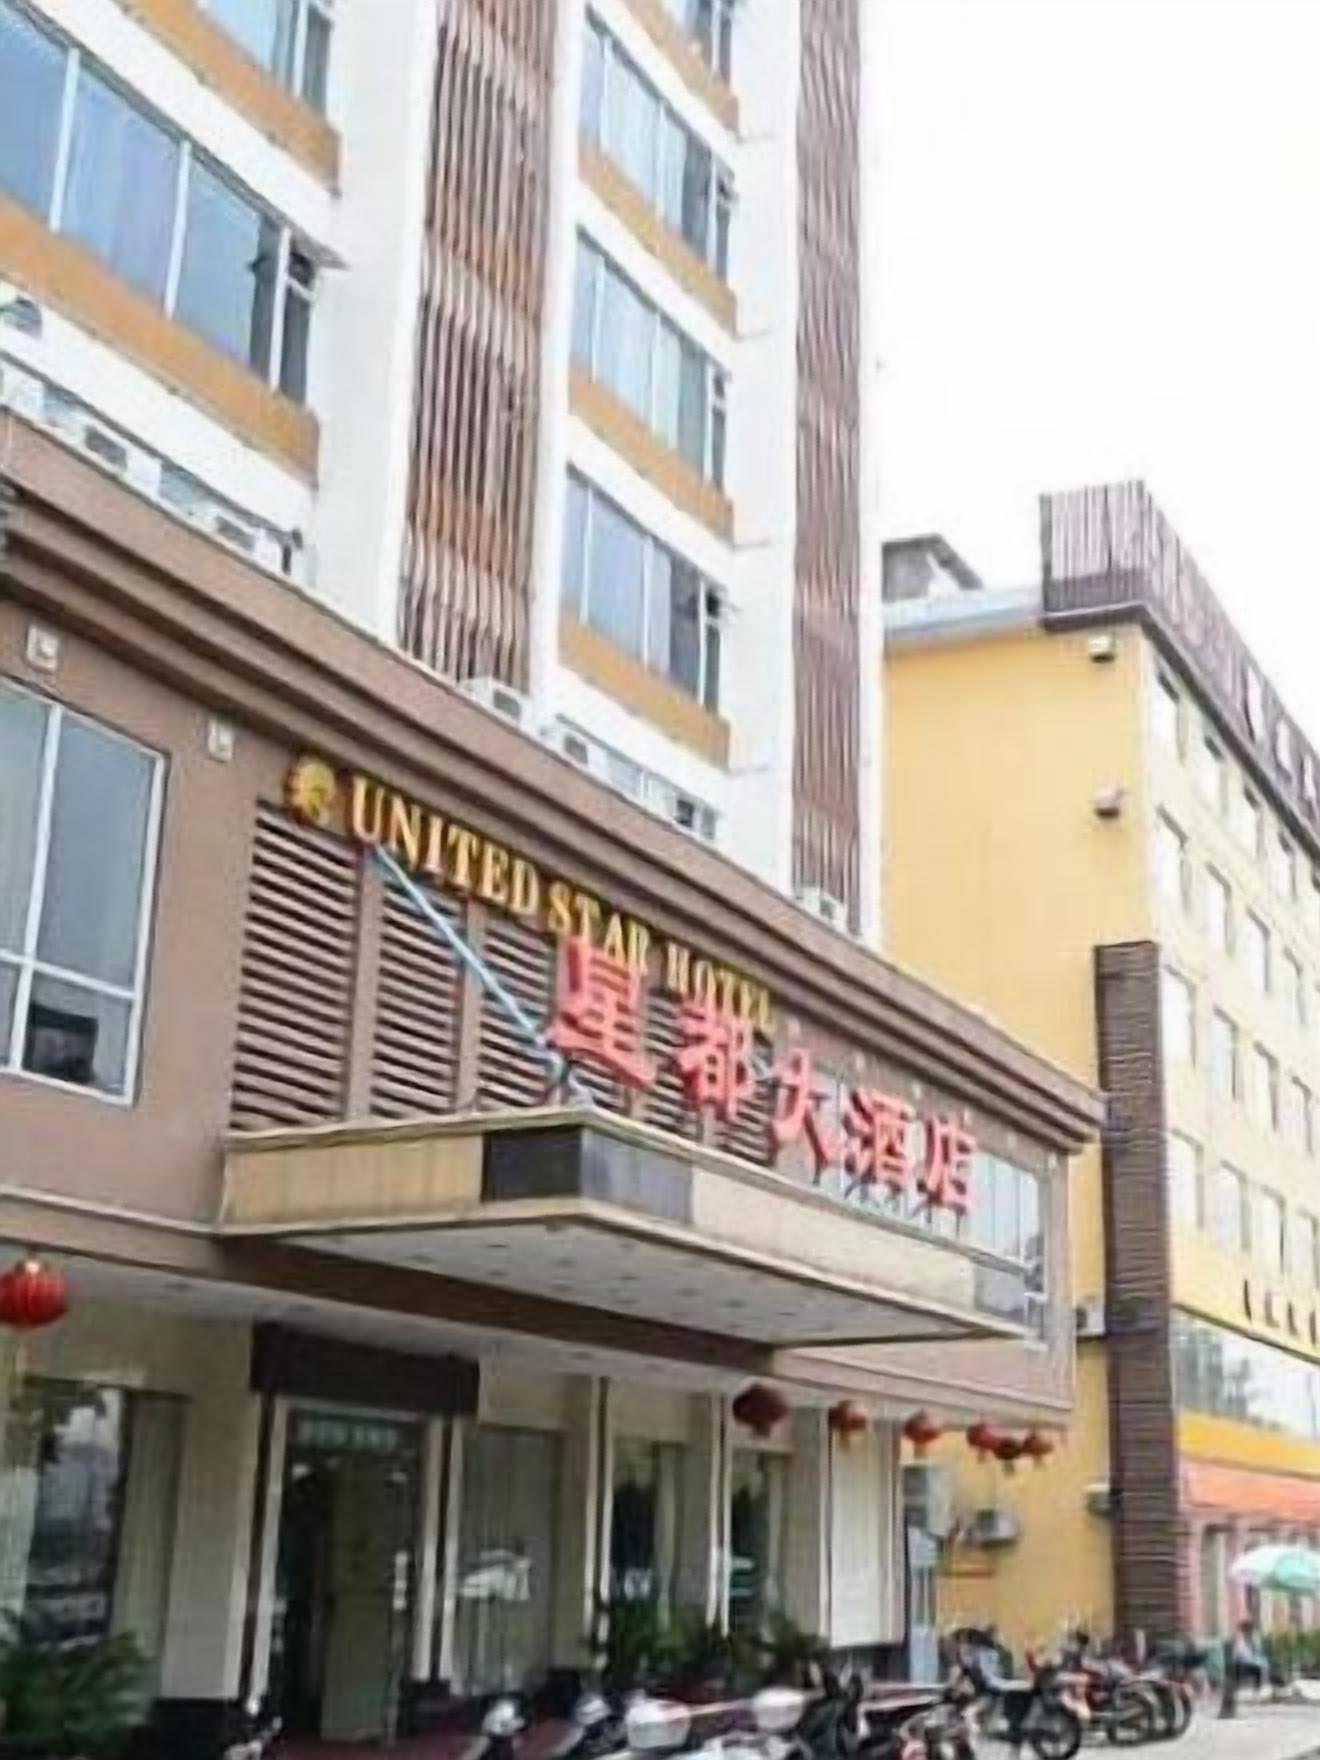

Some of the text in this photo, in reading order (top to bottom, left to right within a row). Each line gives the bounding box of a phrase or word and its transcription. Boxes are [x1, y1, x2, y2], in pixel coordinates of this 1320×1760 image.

[351, 775, 541, 917] UNITED
[547, 880, 651, 976] STAR
[548, 935, 978, 1216] 星都大酒店
